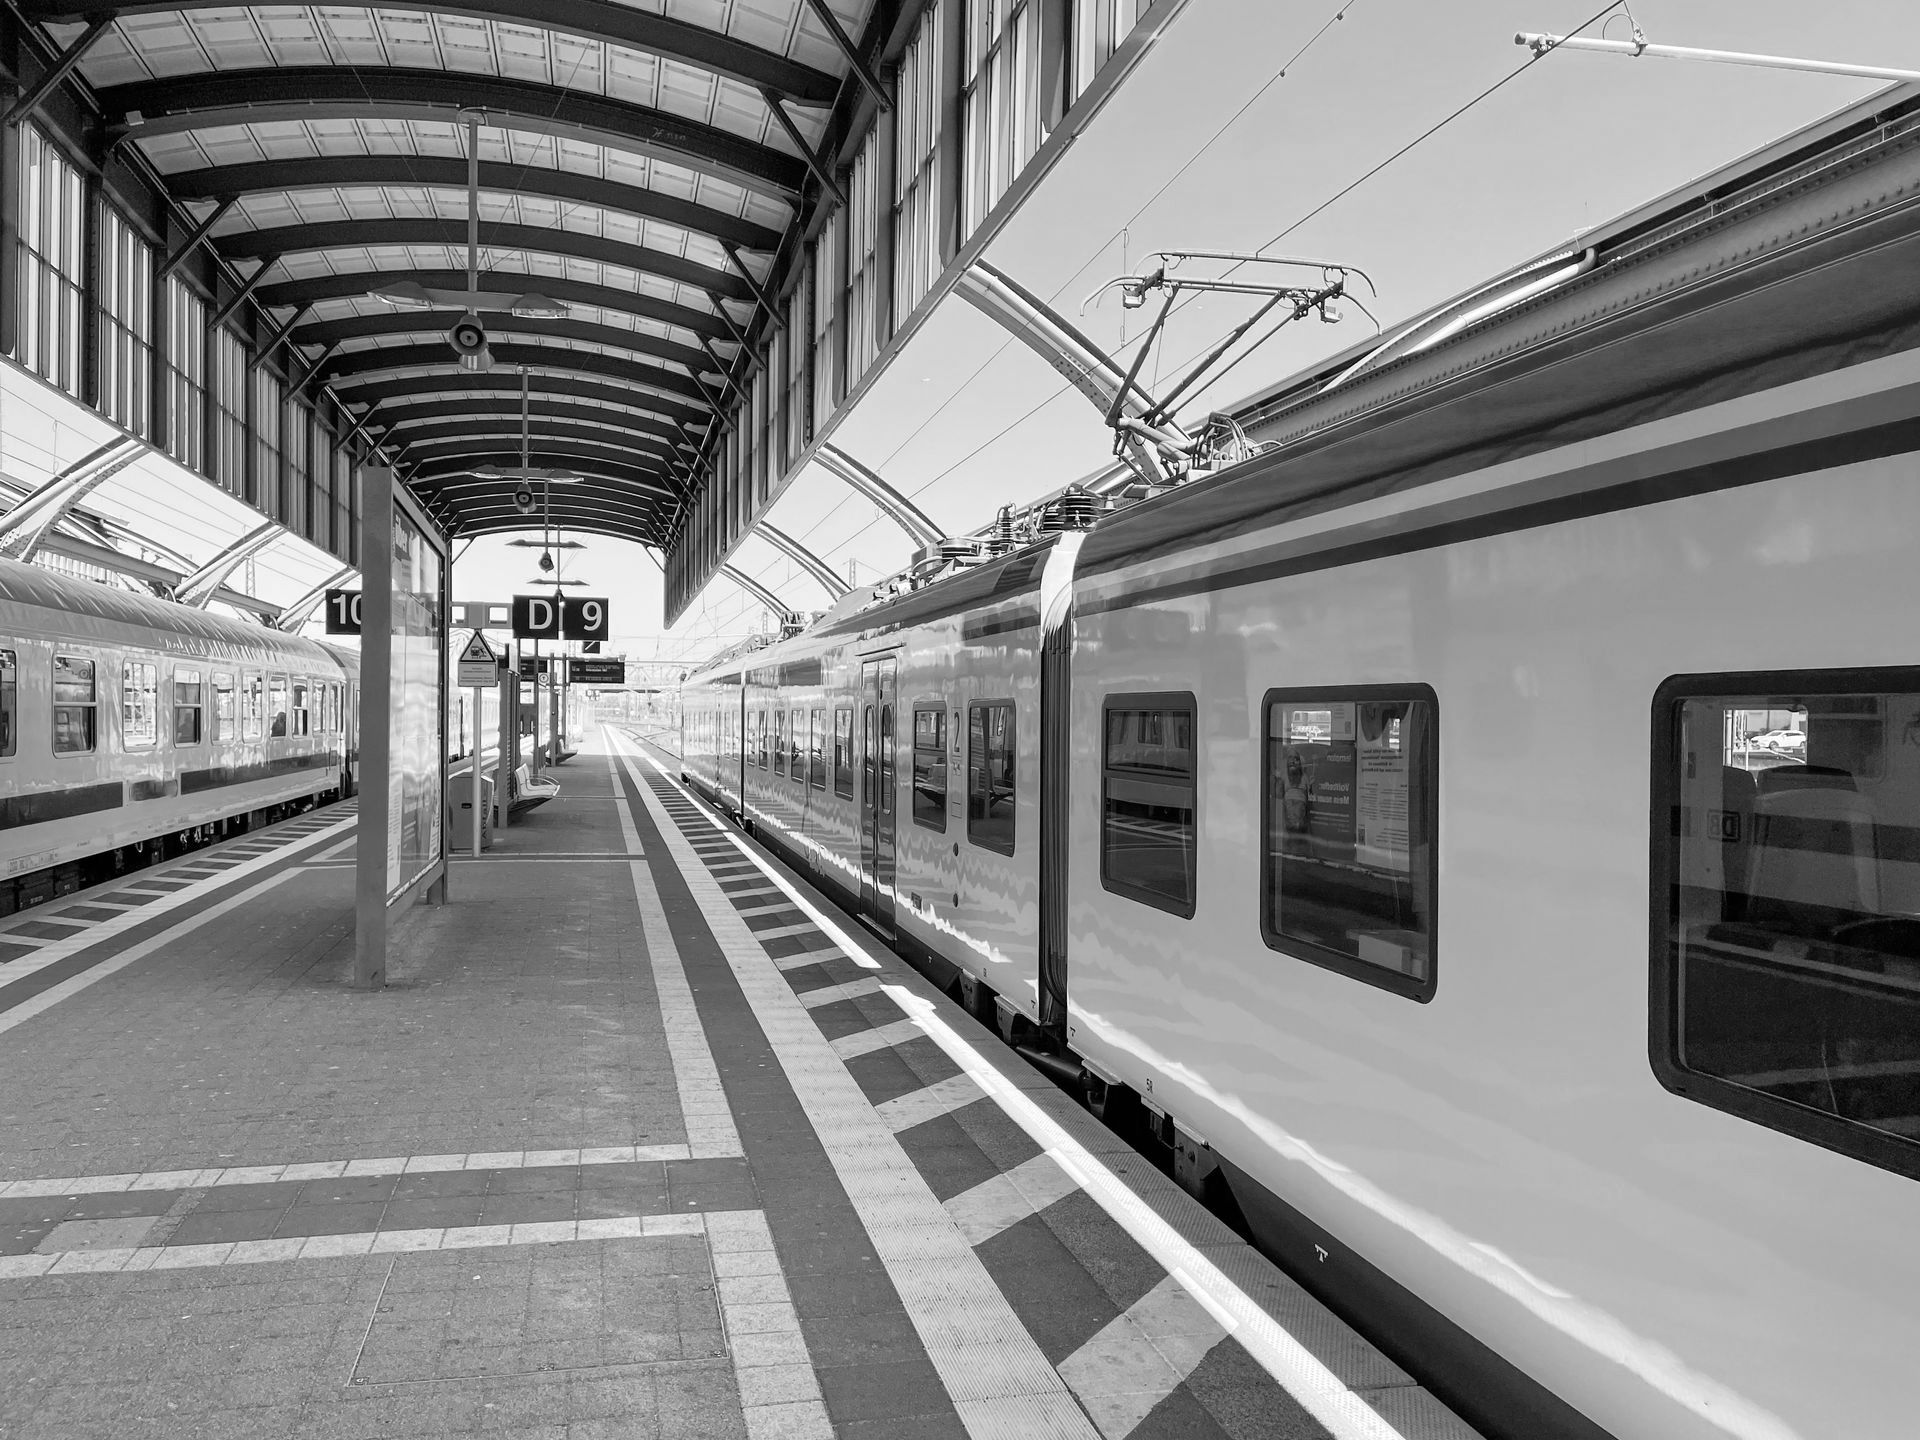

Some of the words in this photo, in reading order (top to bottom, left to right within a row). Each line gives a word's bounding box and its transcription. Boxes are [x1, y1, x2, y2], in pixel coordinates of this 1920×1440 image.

[529, 599, 553, 630] D
[582, 601, 602, 632] 9
[953, 711, 960, 752] 2
